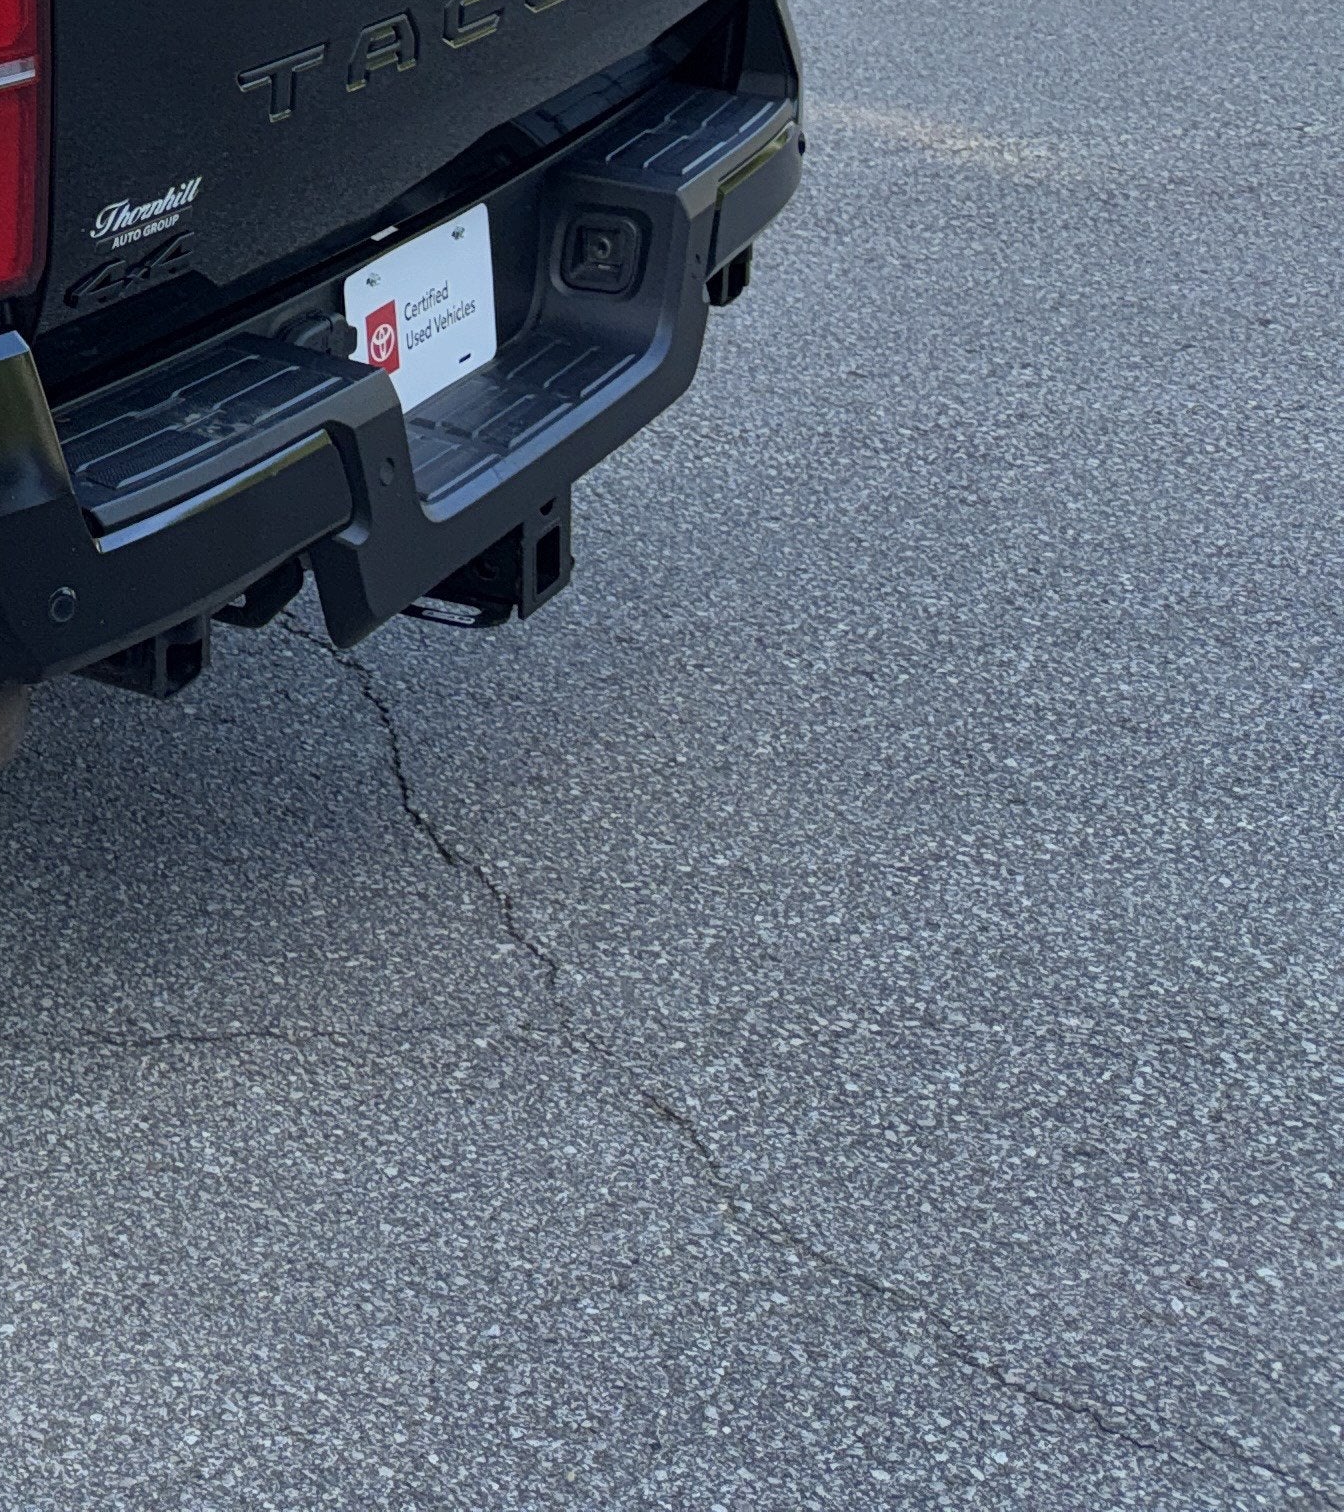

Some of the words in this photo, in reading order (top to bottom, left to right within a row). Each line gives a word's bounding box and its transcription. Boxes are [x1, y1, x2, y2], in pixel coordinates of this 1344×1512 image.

[89, 176, 202, 239] Thornhill
[111, 228, 142, 250] AUTO
[142, 213, 180, 238] GROUP
[403, 280, 449, 322] Certified
[405, 324, 433, 350] Used
[434, 298, 477, 334] Vehicles
